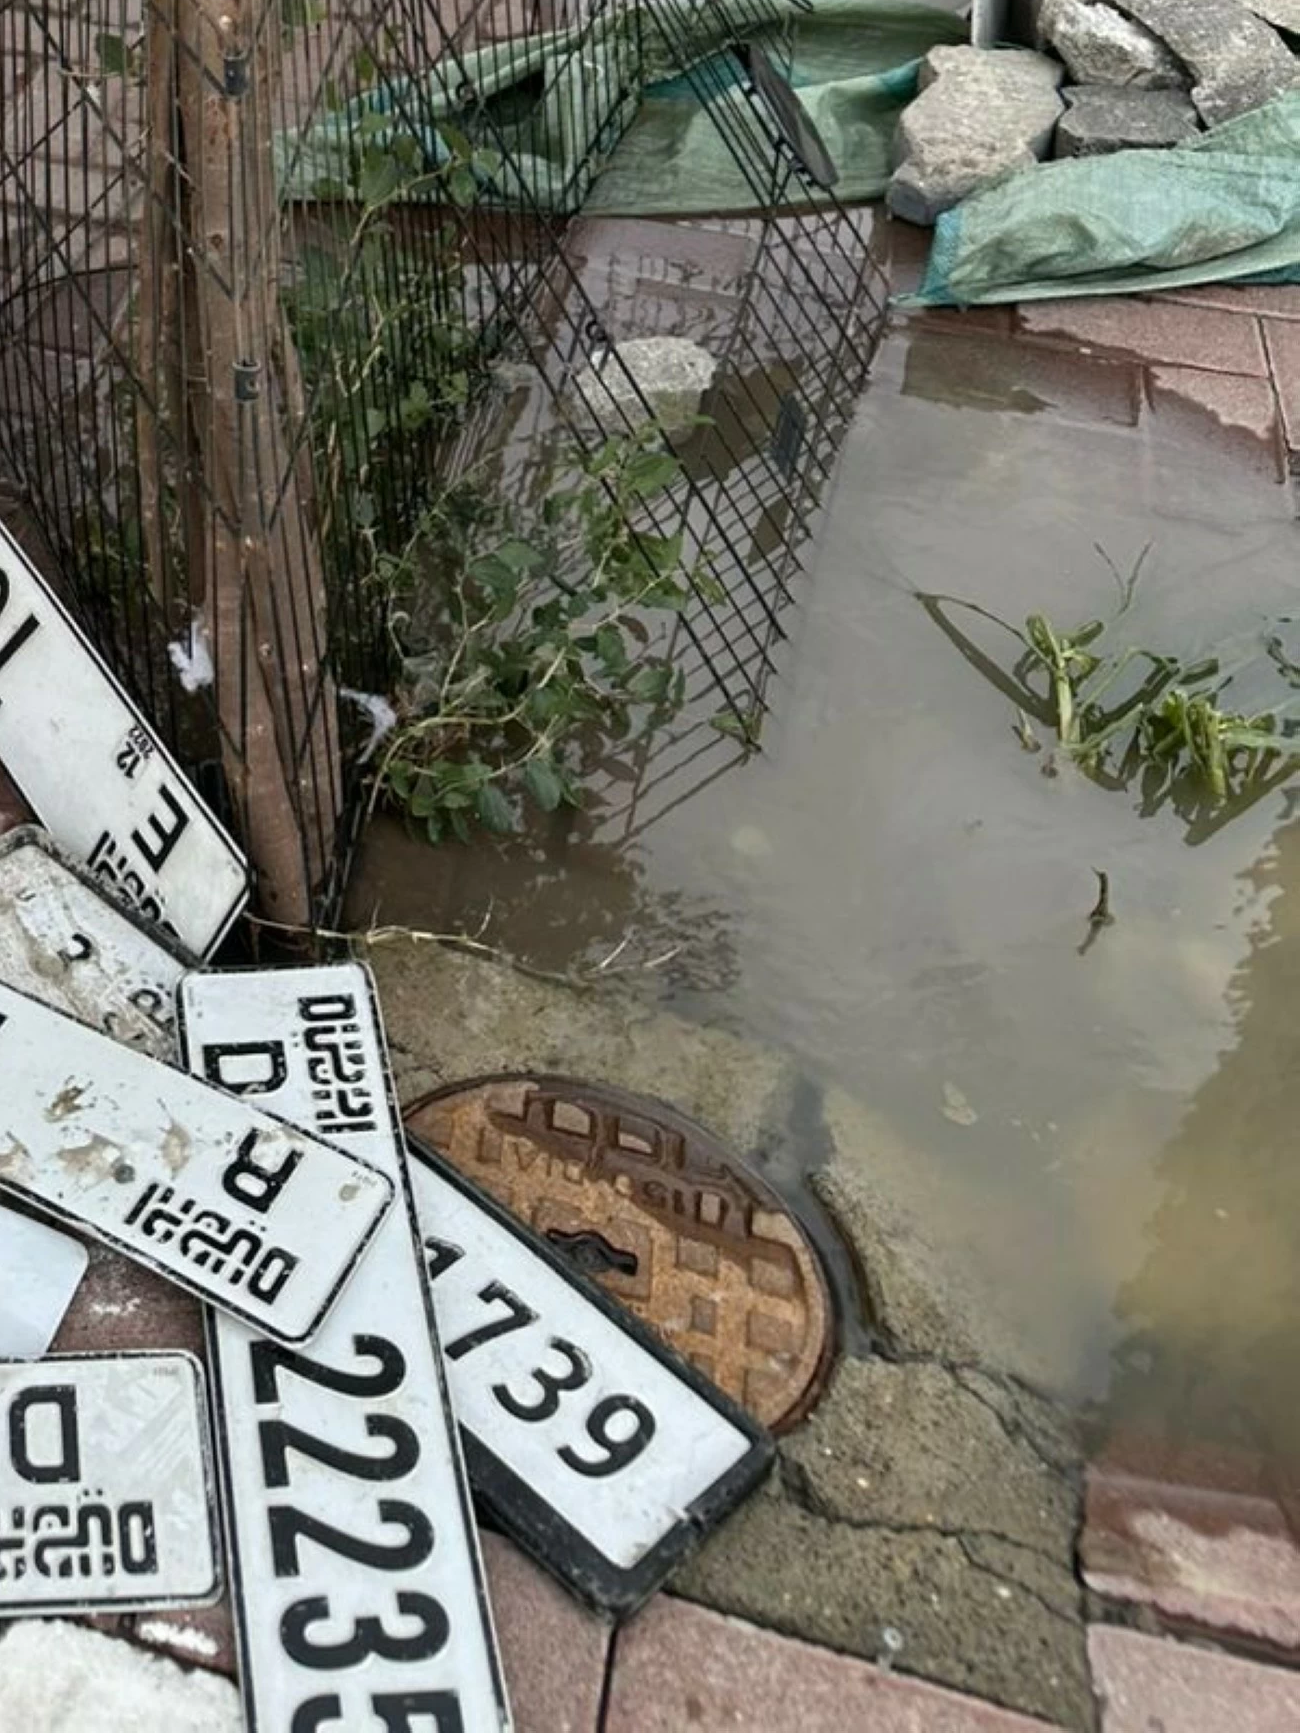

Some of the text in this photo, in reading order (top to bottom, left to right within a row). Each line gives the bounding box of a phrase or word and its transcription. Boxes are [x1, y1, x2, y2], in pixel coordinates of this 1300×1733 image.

[116, 740, 140, 779] 12
[130, 783, 190, 873] E
[201, 1039, 288, 1096] D
[290, 993, 378, 1134] DUBAI
[123, 1182, 299, 1305] DUBAI
[8, 1383, 82, 1485] D
